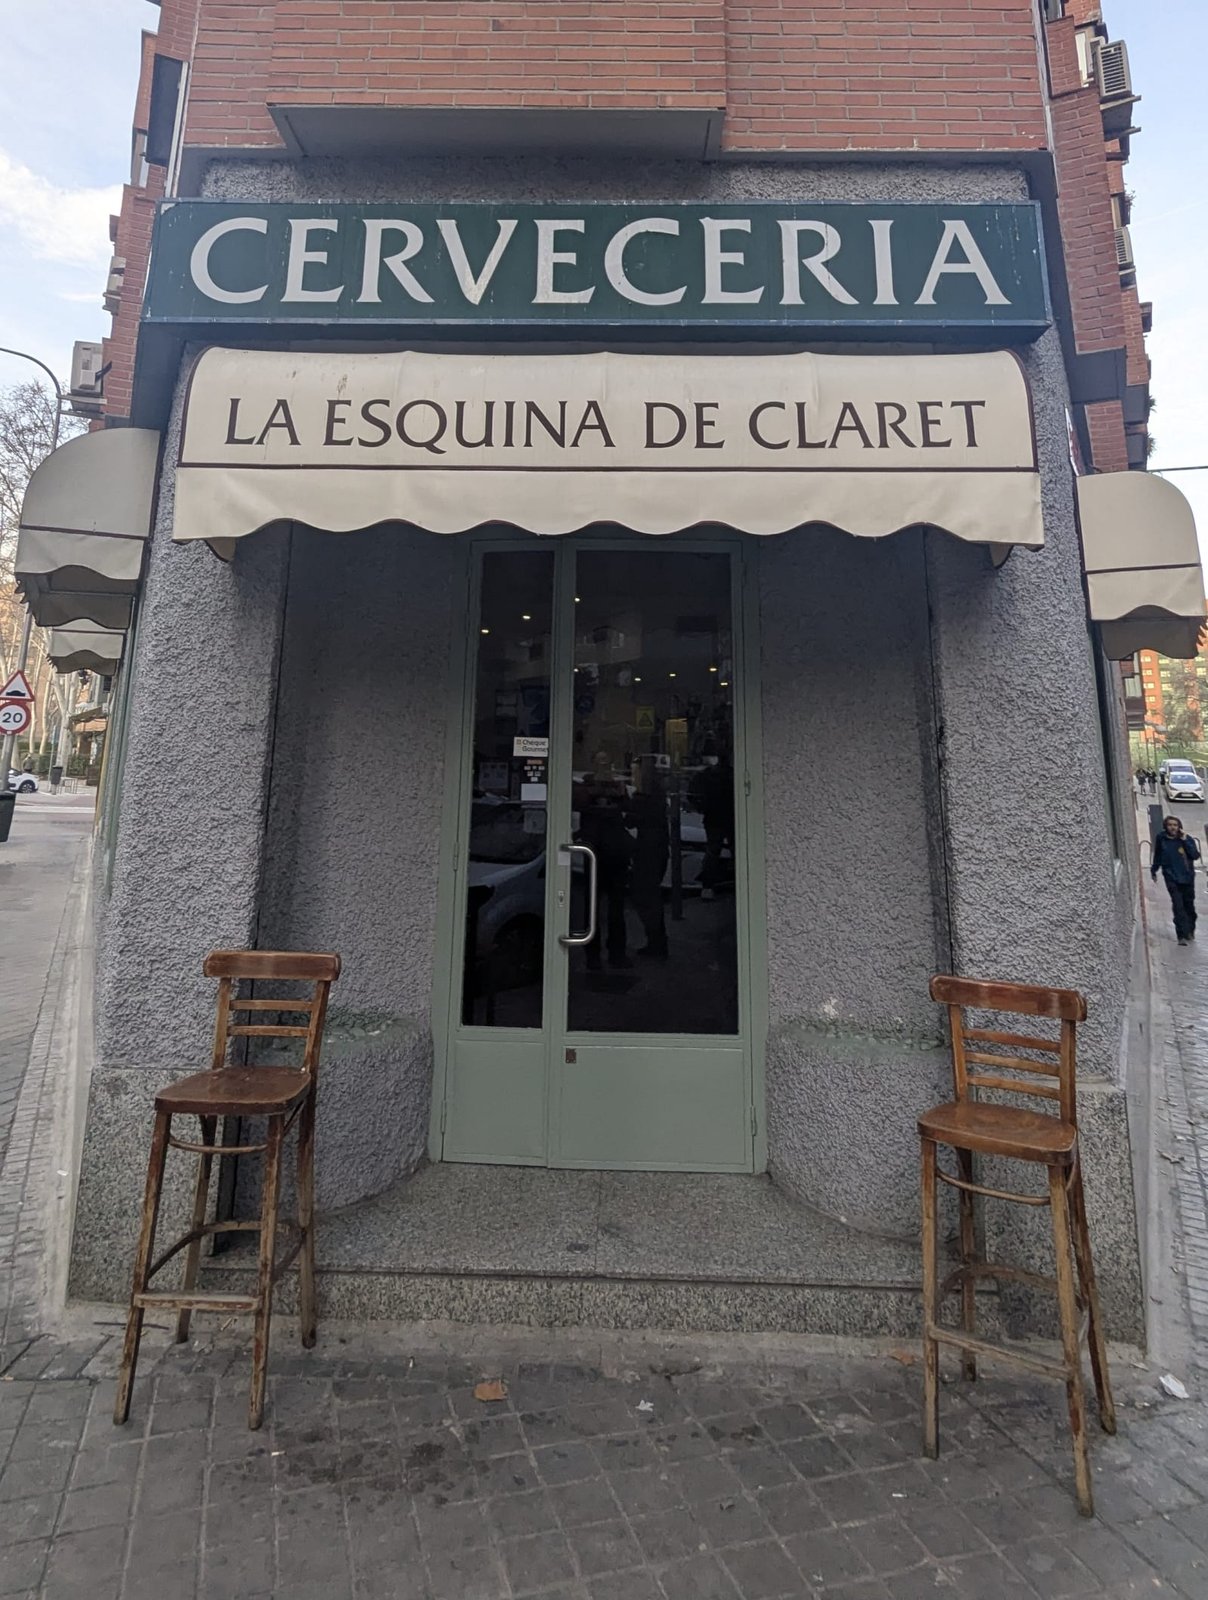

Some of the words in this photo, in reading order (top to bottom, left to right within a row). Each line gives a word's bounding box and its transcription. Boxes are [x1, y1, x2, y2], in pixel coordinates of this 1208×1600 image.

[189, 216, 1012, 307] CERVECERIA
[225, 398, 301, 446] LA
[323, 398, 615, 454] ESQUINA
[644, 401, 725, 450] DE
[748, 400, 987, 450] CLARET
[2, 712, 23, 723] 20
